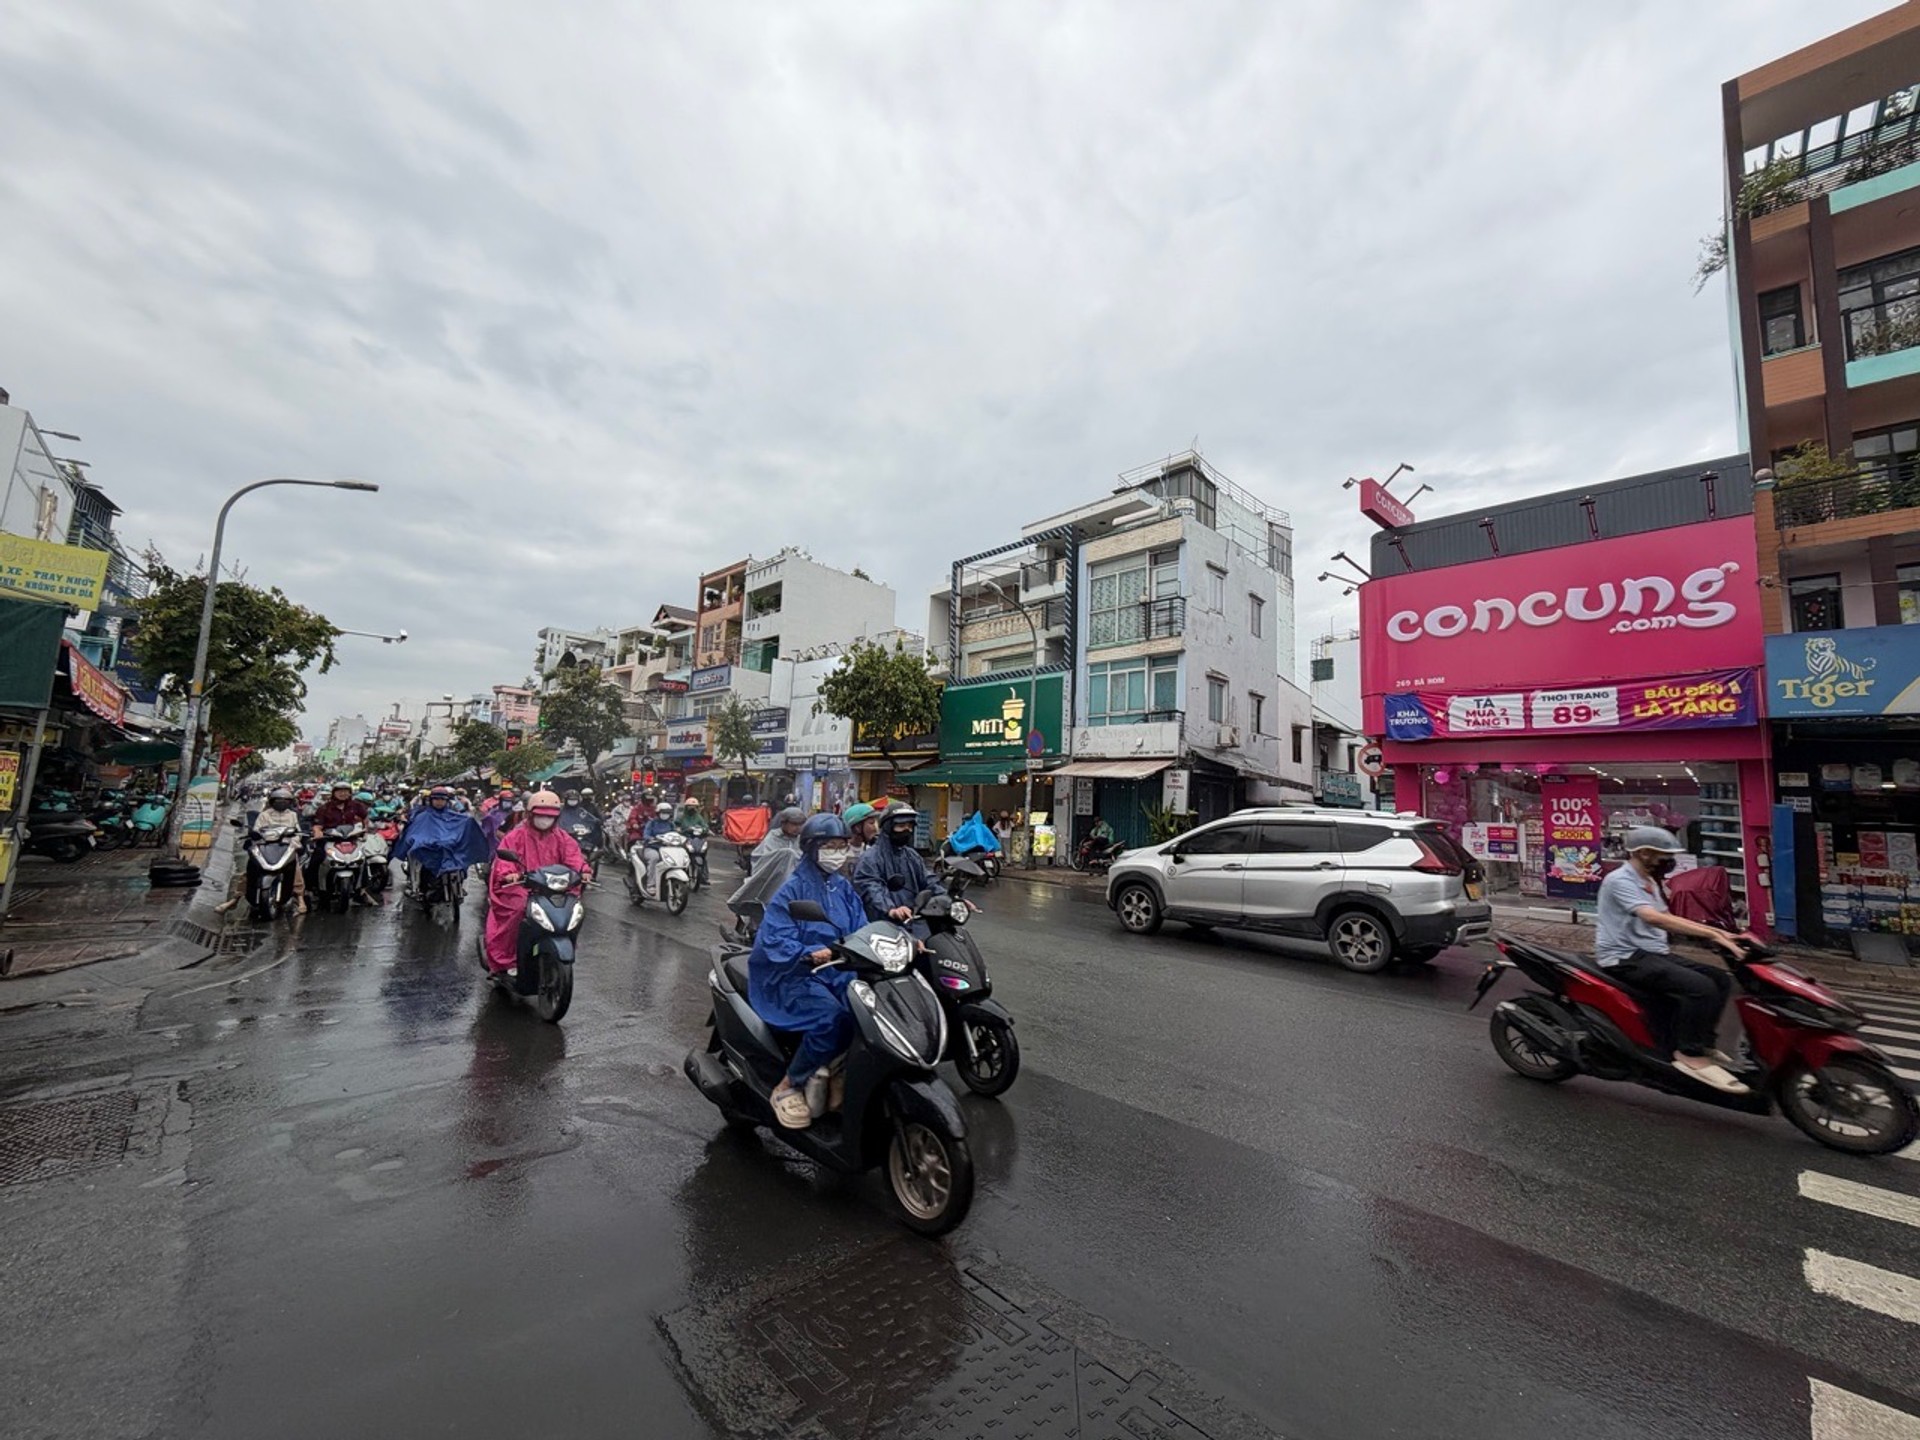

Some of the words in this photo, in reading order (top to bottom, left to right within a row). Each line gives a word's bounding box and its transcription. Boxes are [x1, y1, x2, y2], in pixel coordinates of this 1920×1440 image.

[7, 566, 23, 575] XE
[33, 570, 64, 581] THAY
[1386, 562, 1740, 642] concung
[1609, 615, 1678, 634] .com
[1570, 691, 1610, 700] TRANG
[1777, 674, 1875, 708] Tiger
[1397, 710, 1419, 718] KHAI
[1466, 709, 1496, 718] MUA
[1500, 708, 1508, 716] 2
[1633, 701, 1664, 717] LÀ
[1668, 698, 1738, 717] TẶNG
[971, 718, 1004, 735] MiTi
[1504, 717, 1510, 726] 1
[1551, 797, 1592, 811] 100%
[1551, 809, 1594, 826] QUÀ
